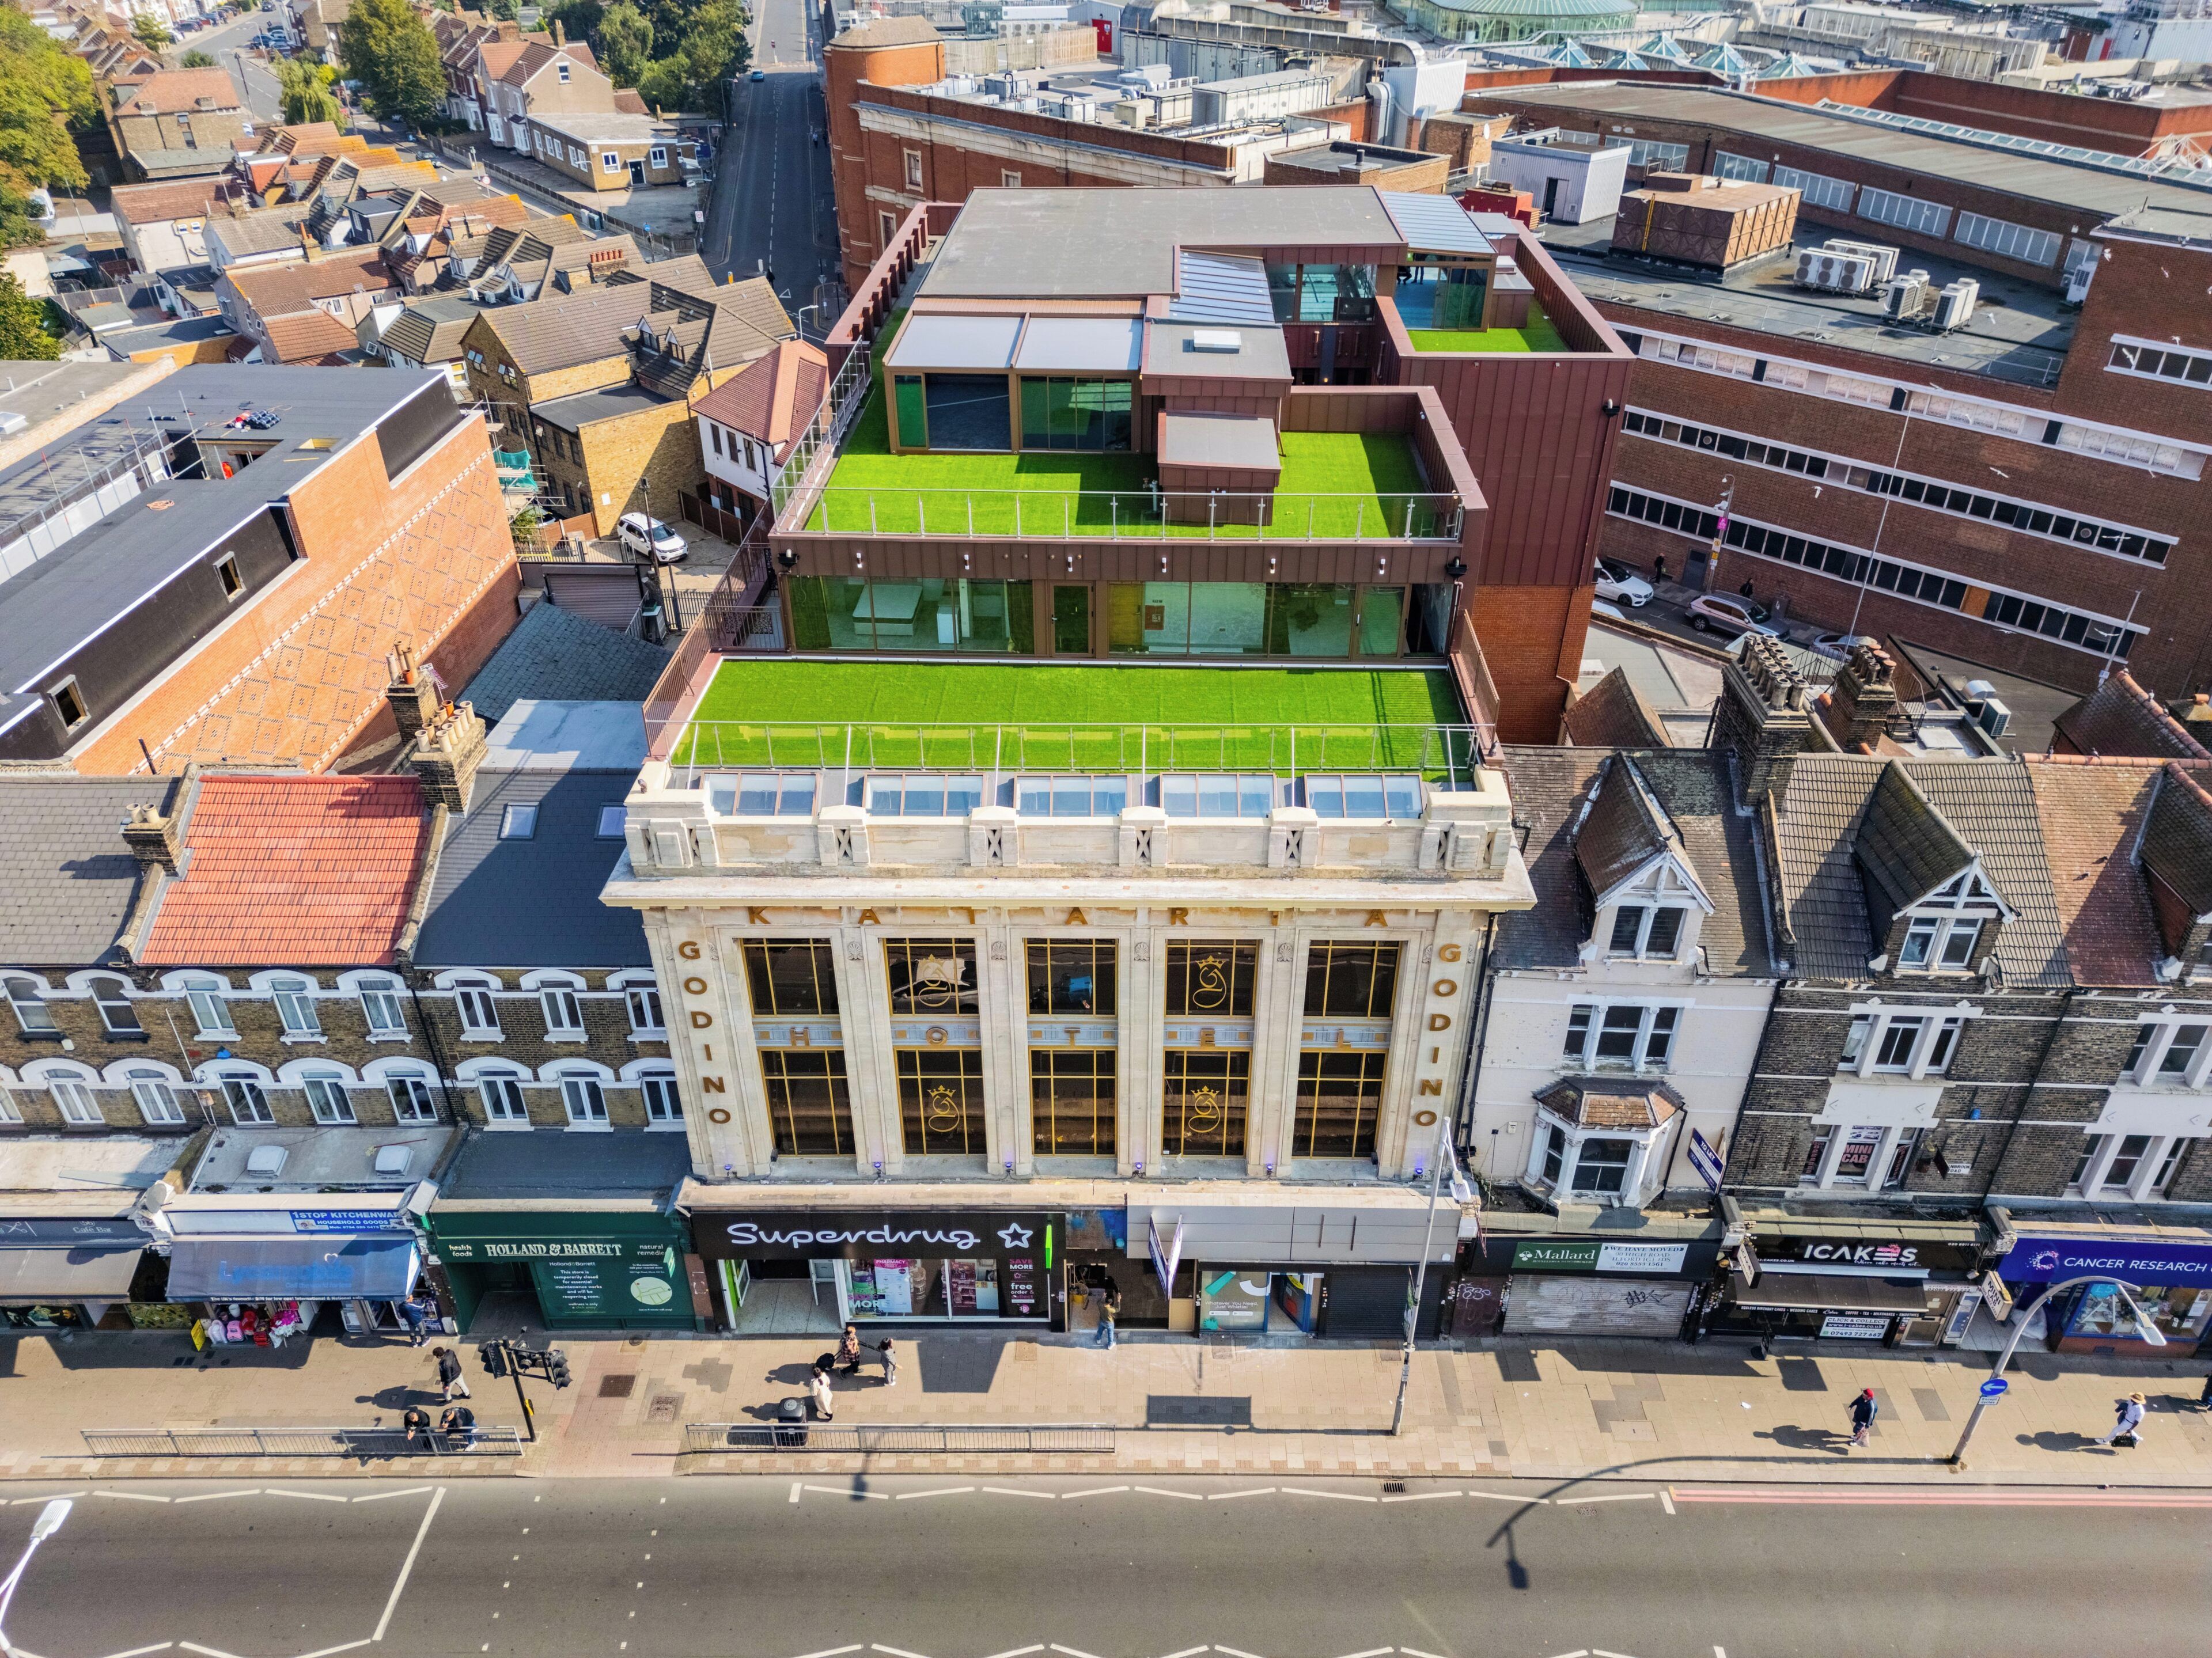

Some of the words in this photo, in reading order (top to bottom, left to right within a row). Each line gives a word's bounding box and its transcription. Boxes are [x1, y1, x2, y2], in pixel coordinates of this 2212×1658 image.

[679, 941, 731, 1124] GODINO
[790, 1027, 1351, 1048] HOTEL
[1415, 943, 1461, 1126] GODINO
[1700, 1141, 1707, 1149] TO
[1707, 1149, 1715, 1162] LET
[1842, 1154, 1869, 1163] CAB
[1845, 1144, 1873, 1154] MINI
[727, 1223, 980, 1249] Superdrug
[485, 1244, 547, 1257] HOLLAND
[549, 1244, 562, 1256] &
[562, 1244, 622, 1256] BARRETT
[1534, 1250, 1596, 1259] Mallard
[2064, 1257, 2125, 1268] CANCER
[2129, 1260, 2207, 1273] RESEARCH
[1988, 1281, 2001, 1305] MINI
[1988, 1289, 1997, 1306] CAB
